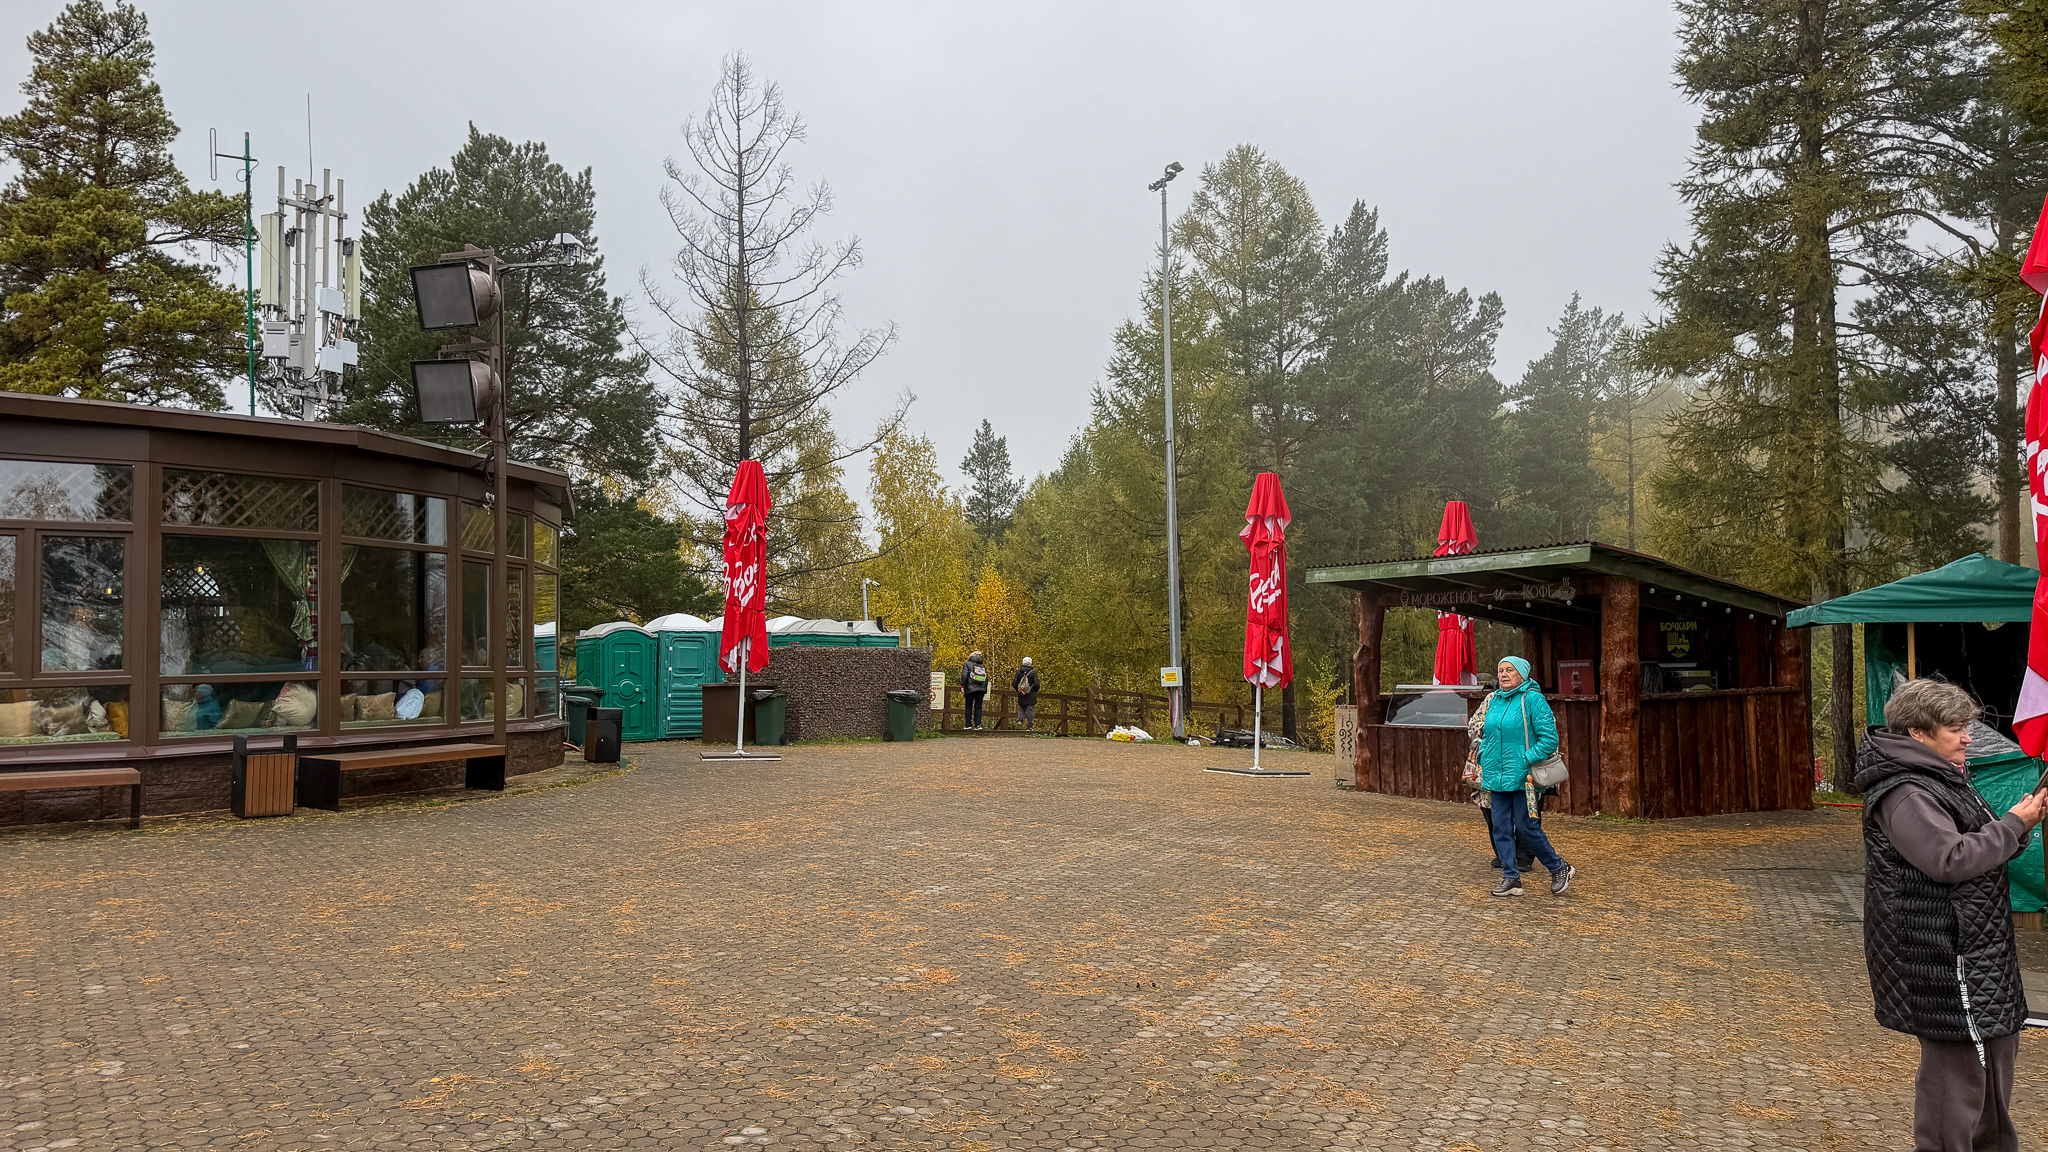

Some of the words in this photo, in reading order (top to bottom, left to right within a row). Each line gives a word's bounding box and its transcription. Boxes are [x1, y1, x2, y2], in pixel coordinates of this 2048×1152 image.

[1411, 590, 1477, 605] МОРОЖЕНОЕ
[1523, 584, 1554, 599] КОФЕ
[1660, 621, 1698, 631] БОЧКАРИ
